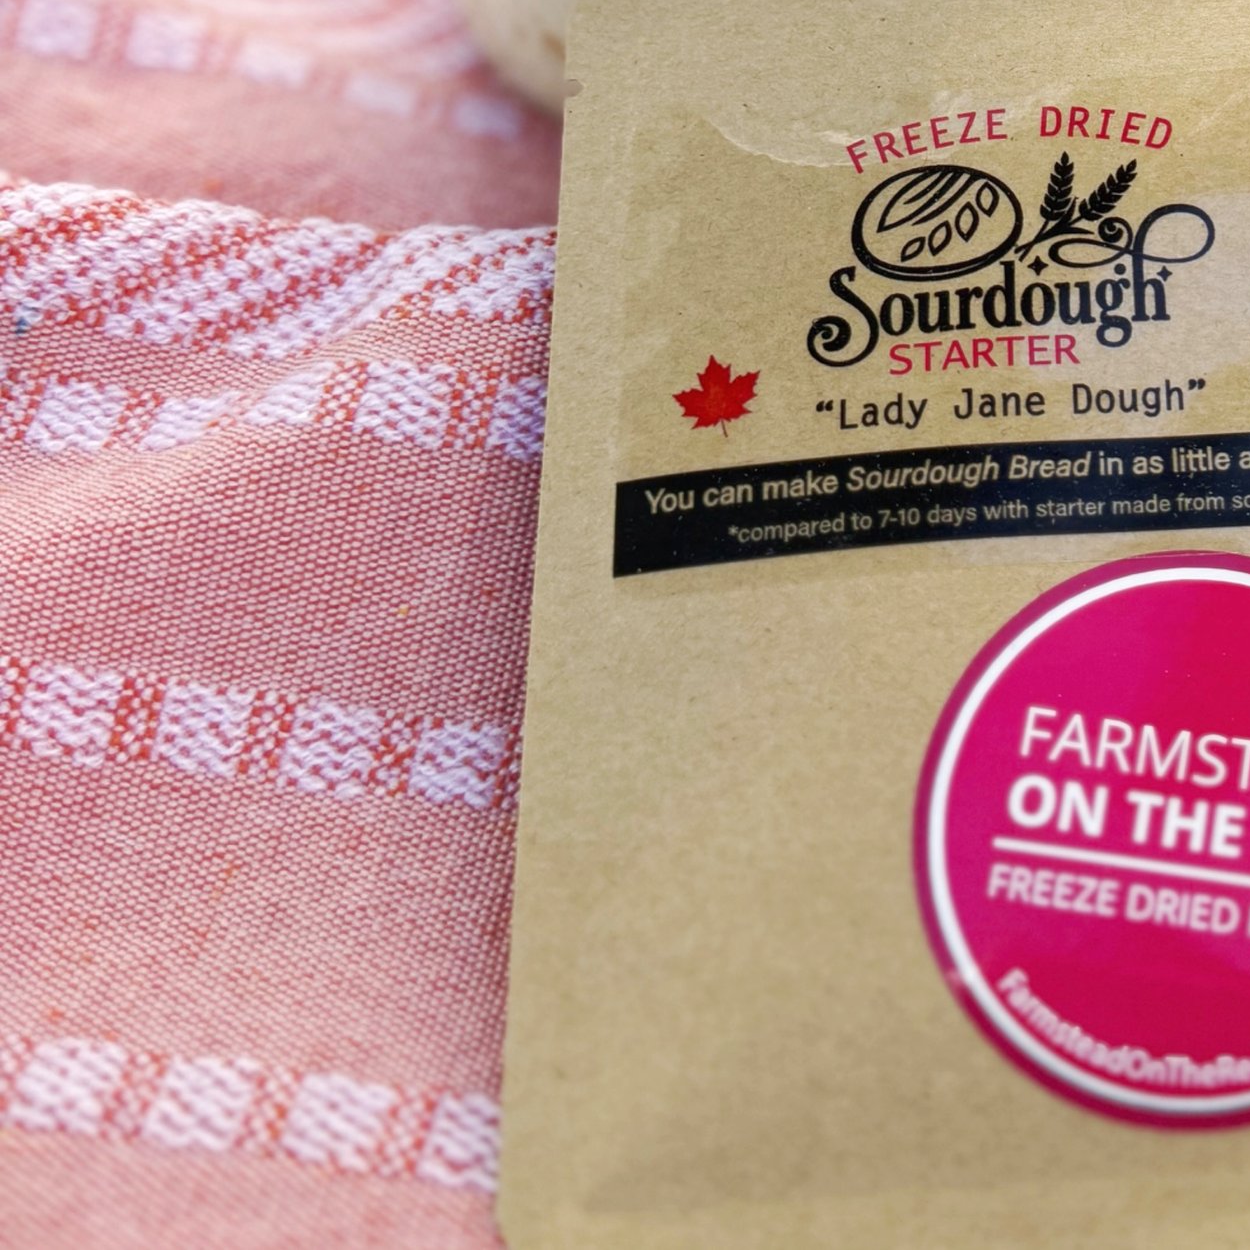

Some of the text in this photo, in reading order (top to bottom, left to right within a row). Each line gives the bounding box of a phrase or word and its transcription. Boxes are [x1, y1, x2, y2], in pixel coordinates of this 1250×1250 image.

[846, 106, 1173, 174] FREEZE DRIED
[806, 230, 1178, 368] Sourdough
[889, 334, 1080, 376] STARTER
[954, 388, 1045, 420] Jane
[645, 487, 695, 515] You
[703, 485, 753, 507] can
[762, 471, 839, 500] make
[847, 455, 1000, 492] Sourdough
[1008, 452, 1091, 480] Bread
[1099, 451, 1124, 476] in
[1132, 453, 1164, 475] as
[1172, 446, 1230, 473] little
[851, 512, 872, 530] to
[880, 507, 920, 528] 7-10
[927, 504, 977, 526] days
[983, 498, 1028, 521] with
[1035, 495, 1104, 518] starter
[1112, 493, 1171, 515] made
[1177, 490, 1225, 512] from
[1007, 773, 1109, 838] ON
[1125, 790, 1248, 859] THE
[987, 863, 1120, 917] FREEZE
[1124, 883, 1240, 934] DRIED
